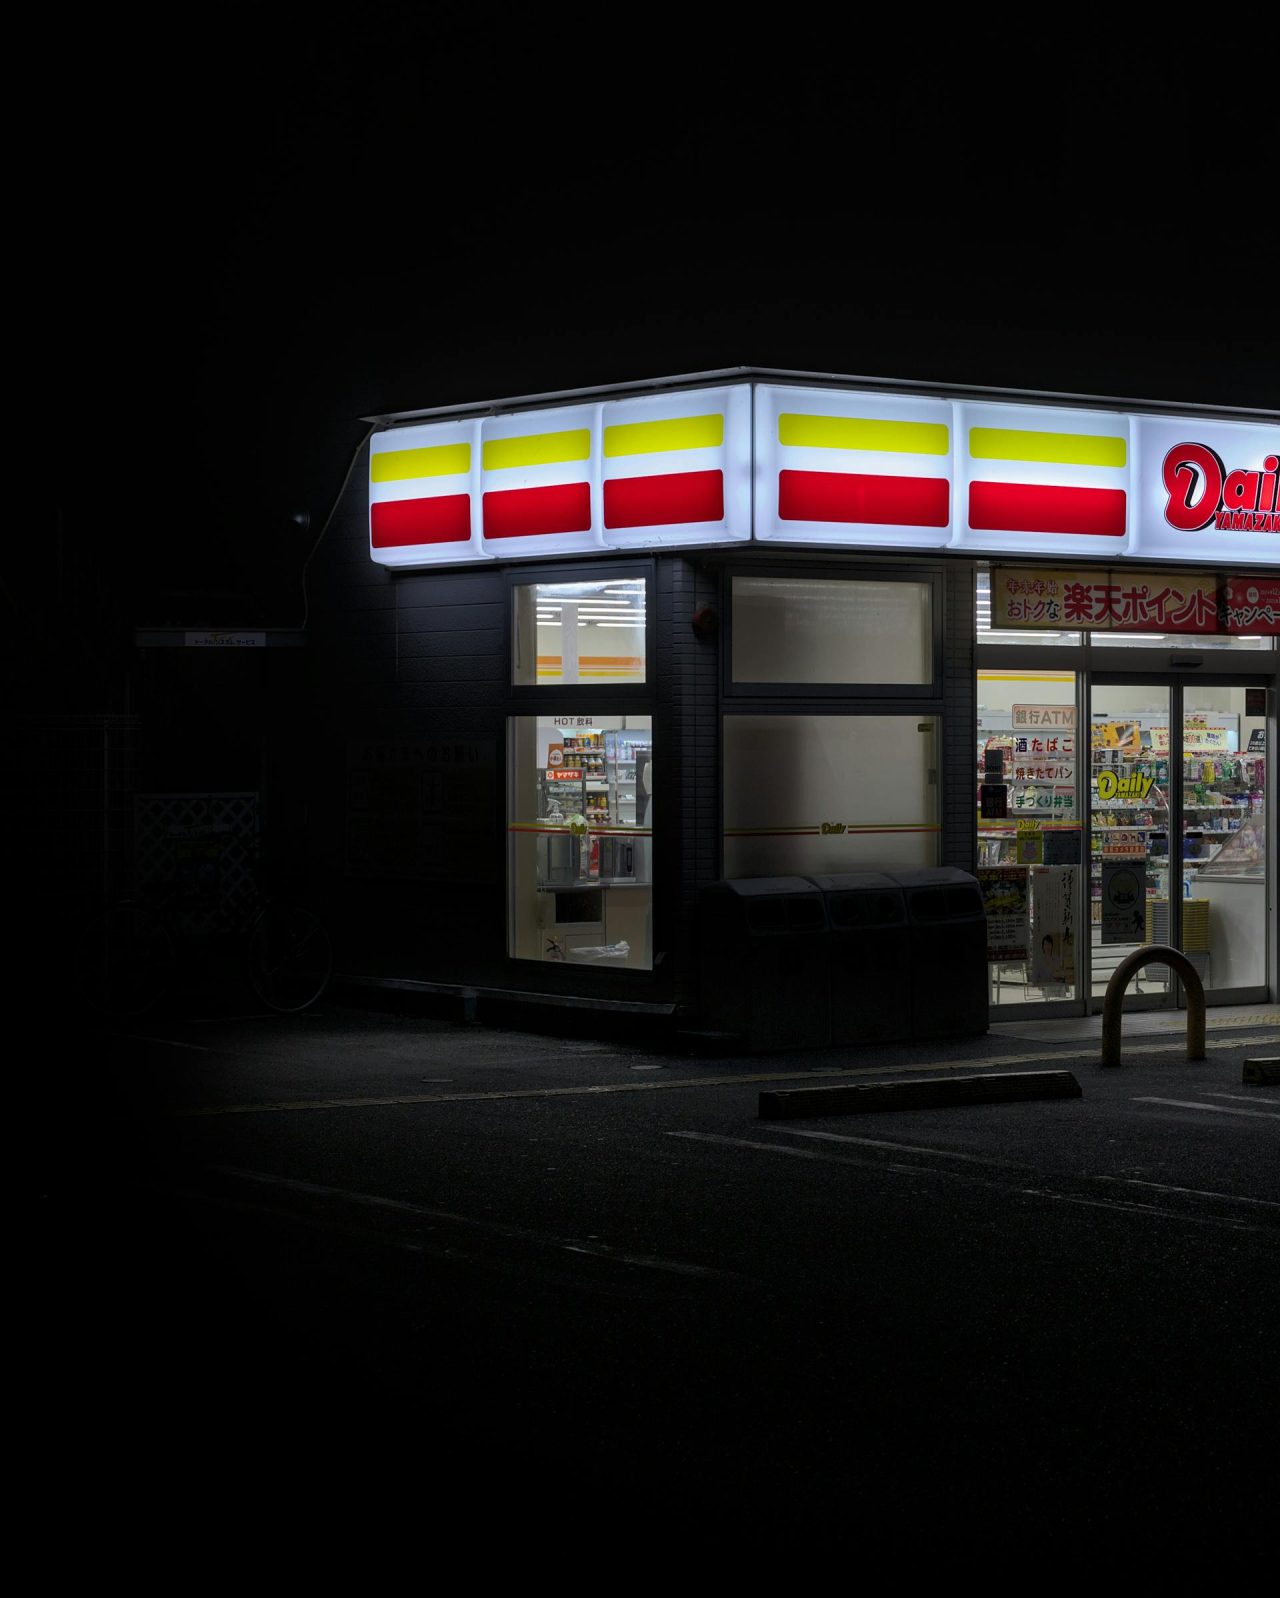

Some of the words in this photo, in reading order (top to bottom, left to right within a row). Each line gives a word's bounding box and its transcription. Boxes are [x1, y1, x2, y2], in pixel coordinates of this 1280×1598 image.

[1007, 598, 1059, 620] おトクな
[1063, 582, 1217, 626] 楽天ポイント
[554, 717, 575, 725] HOT
[576, 717, 593, 726] 飲料
[1015, 710, 1074, 725] 銀行ATM
[1015, 738, 1027, 752] 酒
[1032, 738, 1073, 752] たばこ
[1015, 767, 1073, 780] 焼きたてパン
[1097, 770, 1156, 799] Daily
[1015, 795, 1073, 808] 手づくり弁当
[821, 822, 847, 834] Daily
